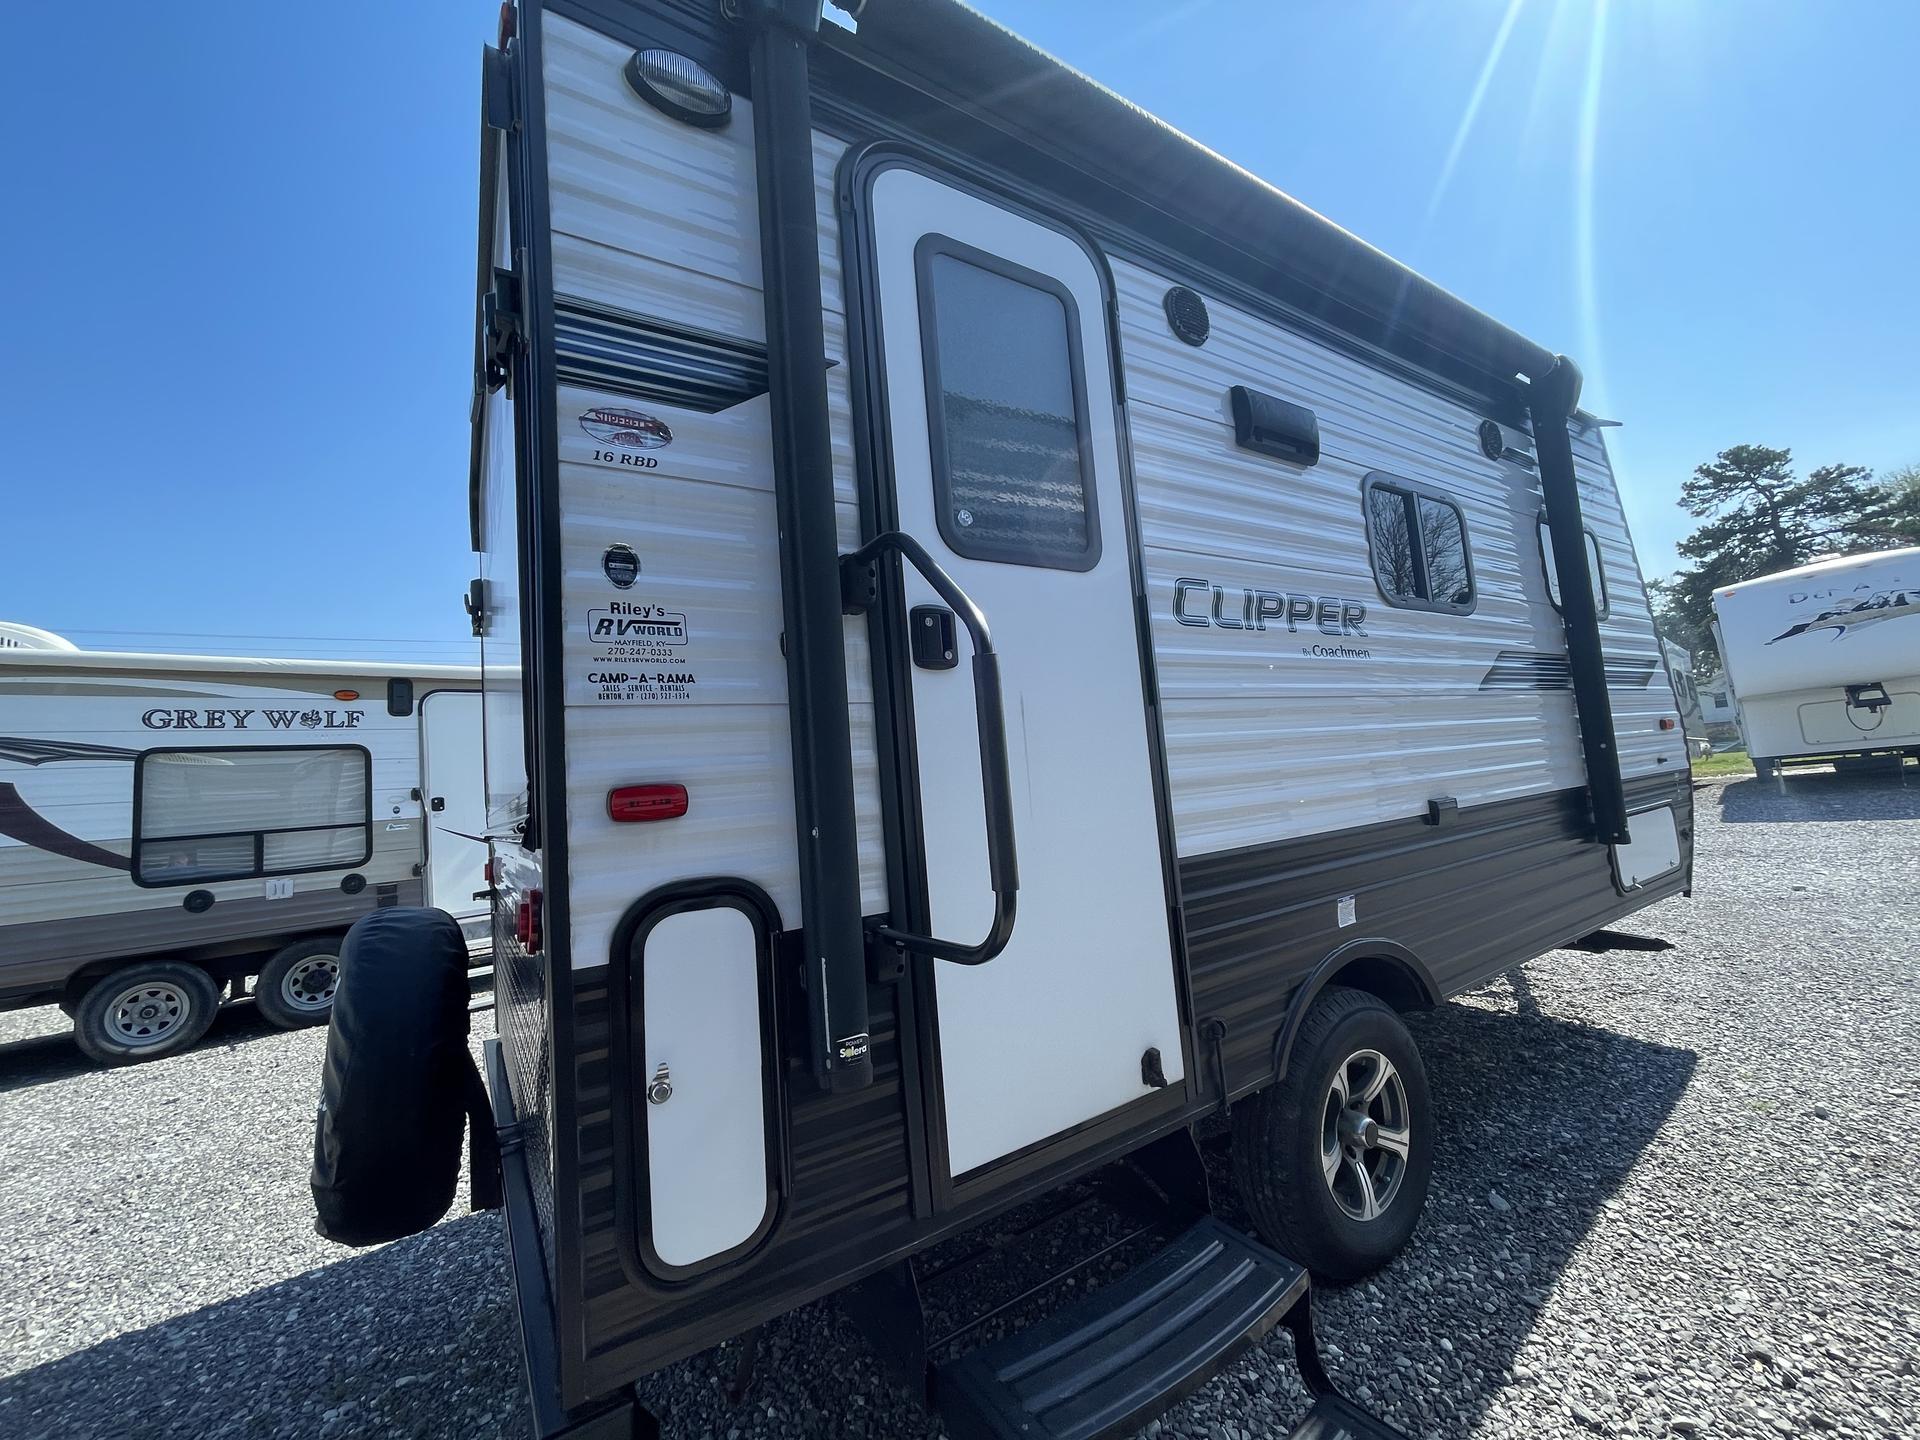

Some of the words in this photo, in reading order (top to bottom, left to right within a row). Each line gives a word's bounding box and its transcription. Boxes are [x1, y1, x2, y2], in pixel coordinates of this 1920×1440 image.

[592, 450, 614, 462] 16
[620, 453, 658, 468] RBD
[610, 602, 665, 618] Riley's
[1173, 577, 1368, 637] CLIPPER
[594, 618, 637, 635] RV
[633, 625, 683, 637] WORLD
[614, 639, 654, 647] MAYFIELD,
[607, 647, 673, 657] 270-247-0333
[1312, 644, 1370, 660] Coachmen
[588, 673, 696, 684] CAMP-A-RAMA
[602, 684, 621, 692] SALES
[628, 684, 653, 692] SERVICE
[660, 684, 685, 692] RENTALS
[142, 709, 255, 729] GREY
[839, 1045, 867, 1058] Solera
